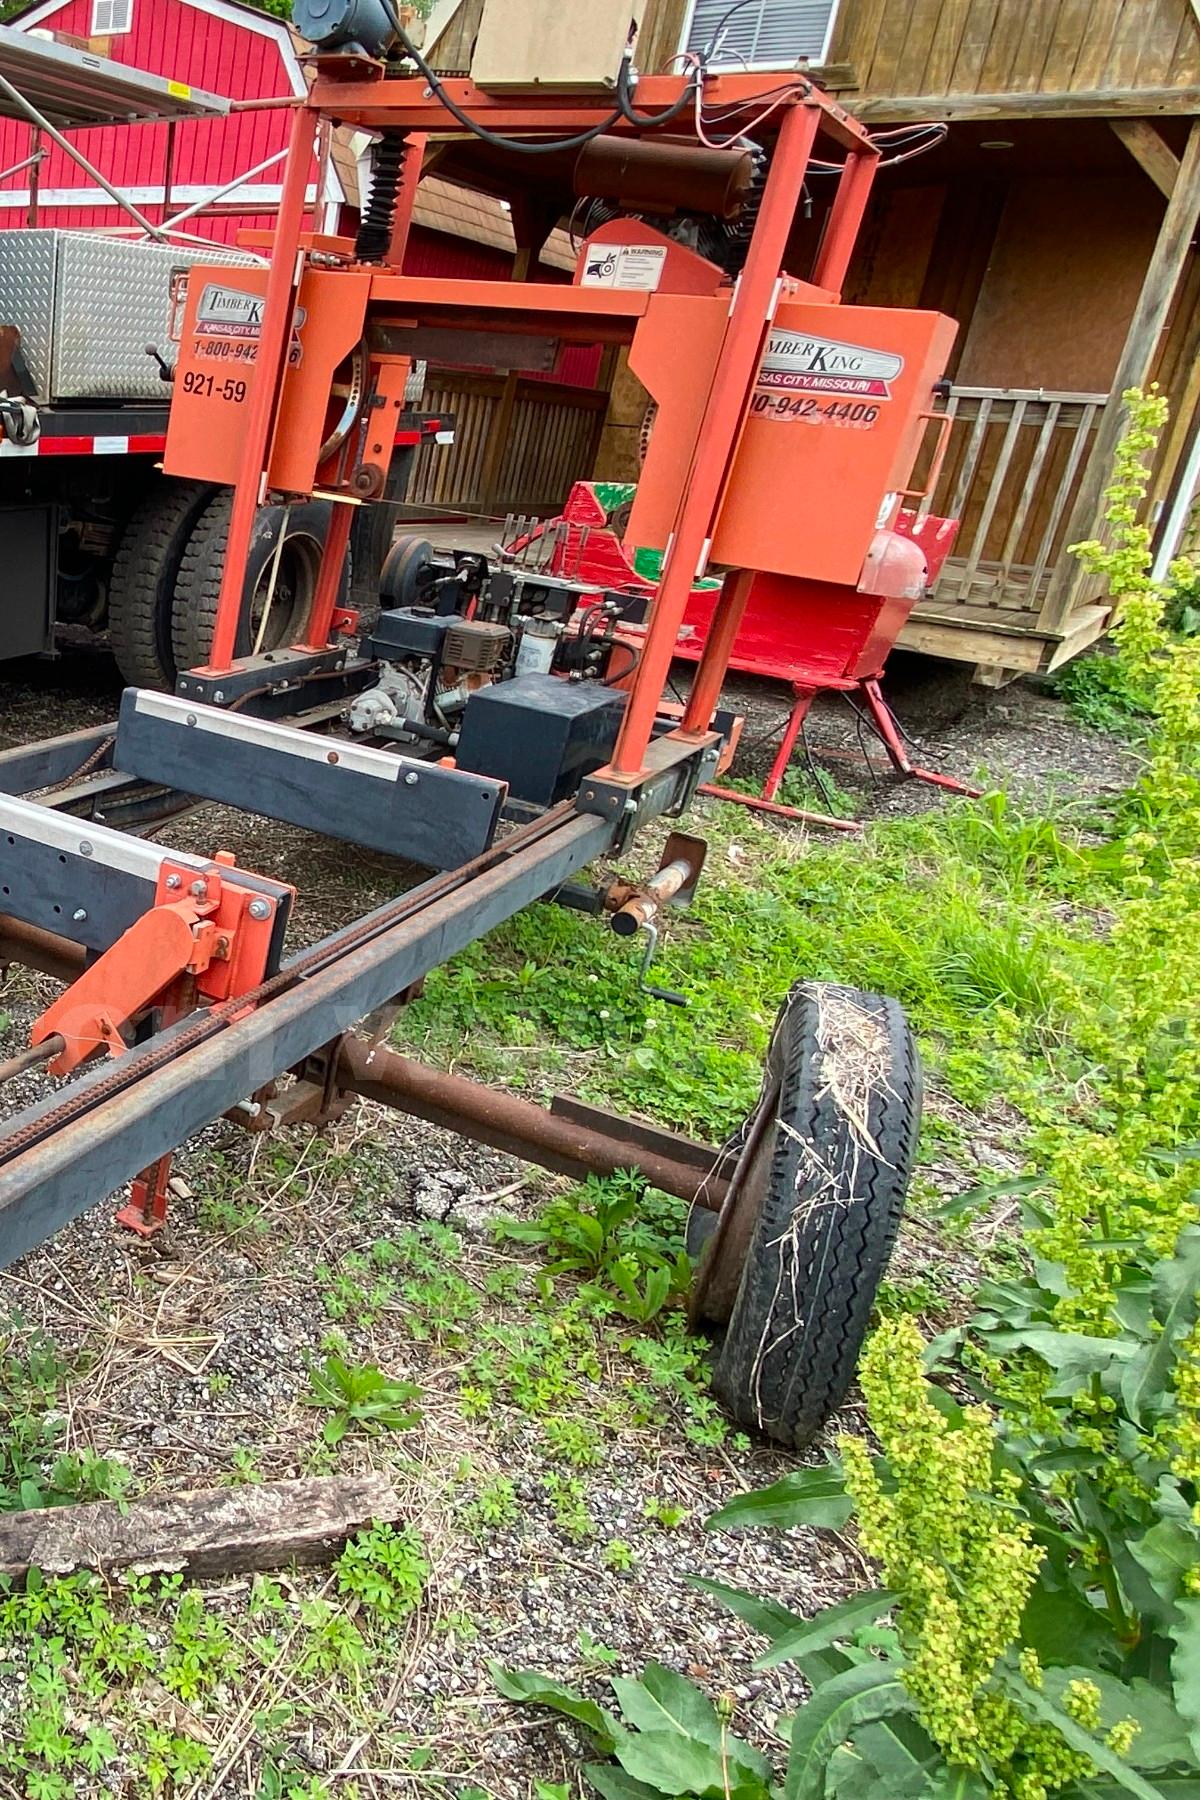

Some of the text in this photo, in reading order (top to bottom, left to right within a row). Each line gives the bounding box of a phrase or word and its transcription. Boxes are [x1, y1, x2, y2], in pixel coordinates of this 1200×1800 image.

[183, 371, 247, 403] 921-59
[758, 373, 783, 384] SAS
[812, 379, 871, 392] MISSOURI
